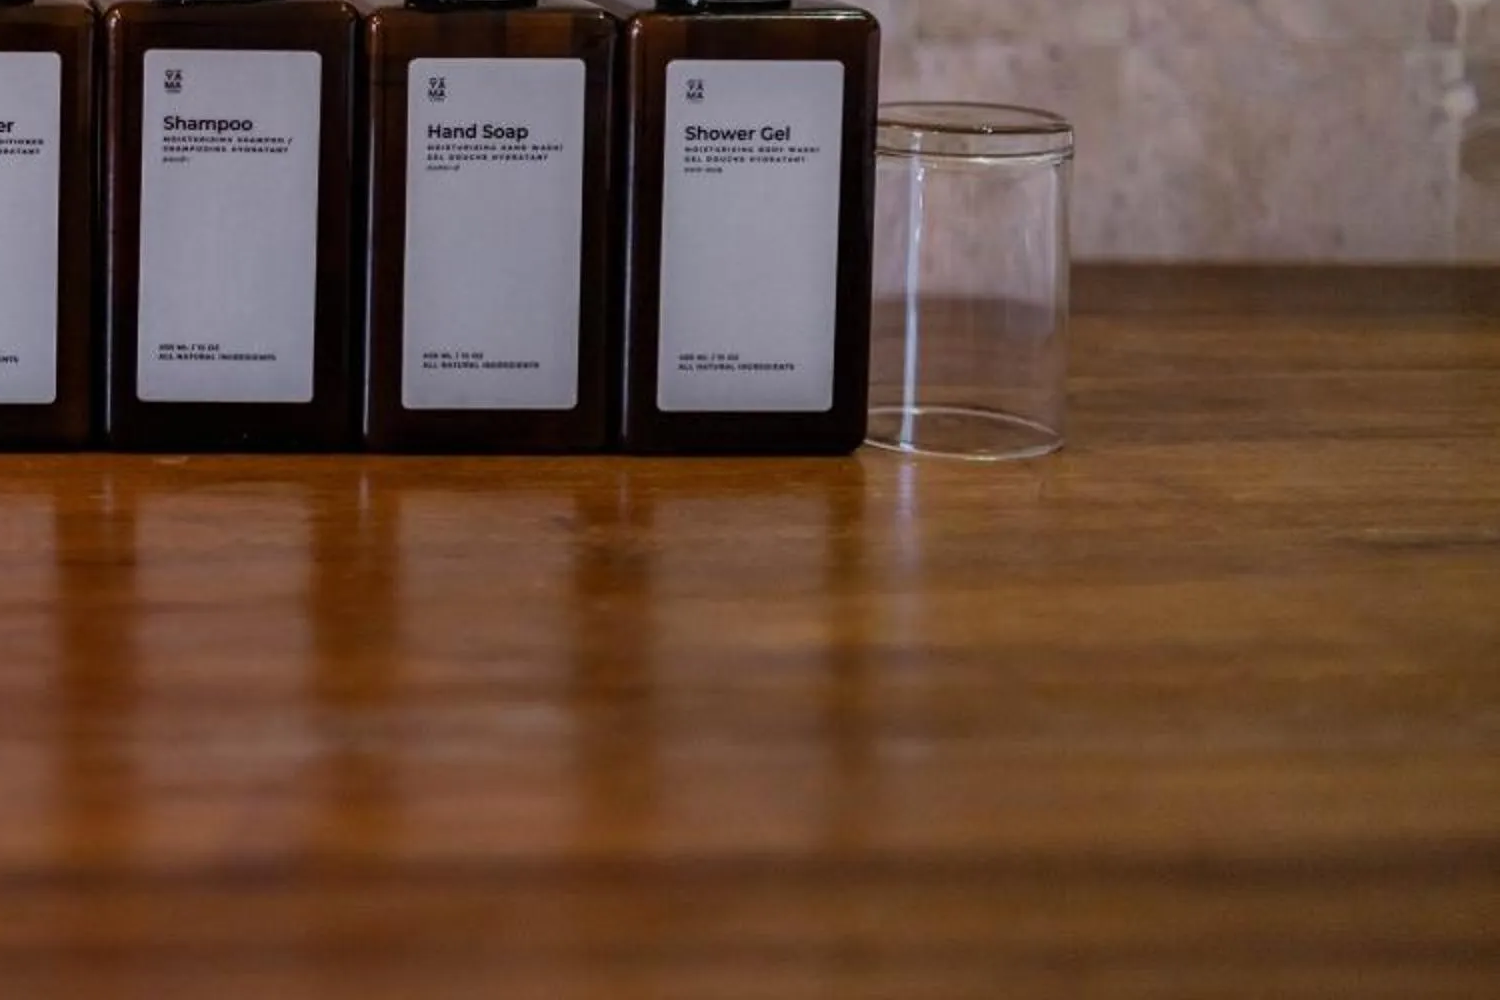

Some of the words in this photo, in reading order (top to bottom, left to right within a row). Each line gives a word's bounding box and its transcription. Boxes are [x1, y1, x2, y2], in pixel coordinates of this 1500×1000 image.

[164, 116, 253, 133] Shampoo
[428, 124, 477, 139] Hand
[483, 125, 529, 141] Soap
[685, 126, 756, 141] Shower
[760, 126, 791, 141] Gel
